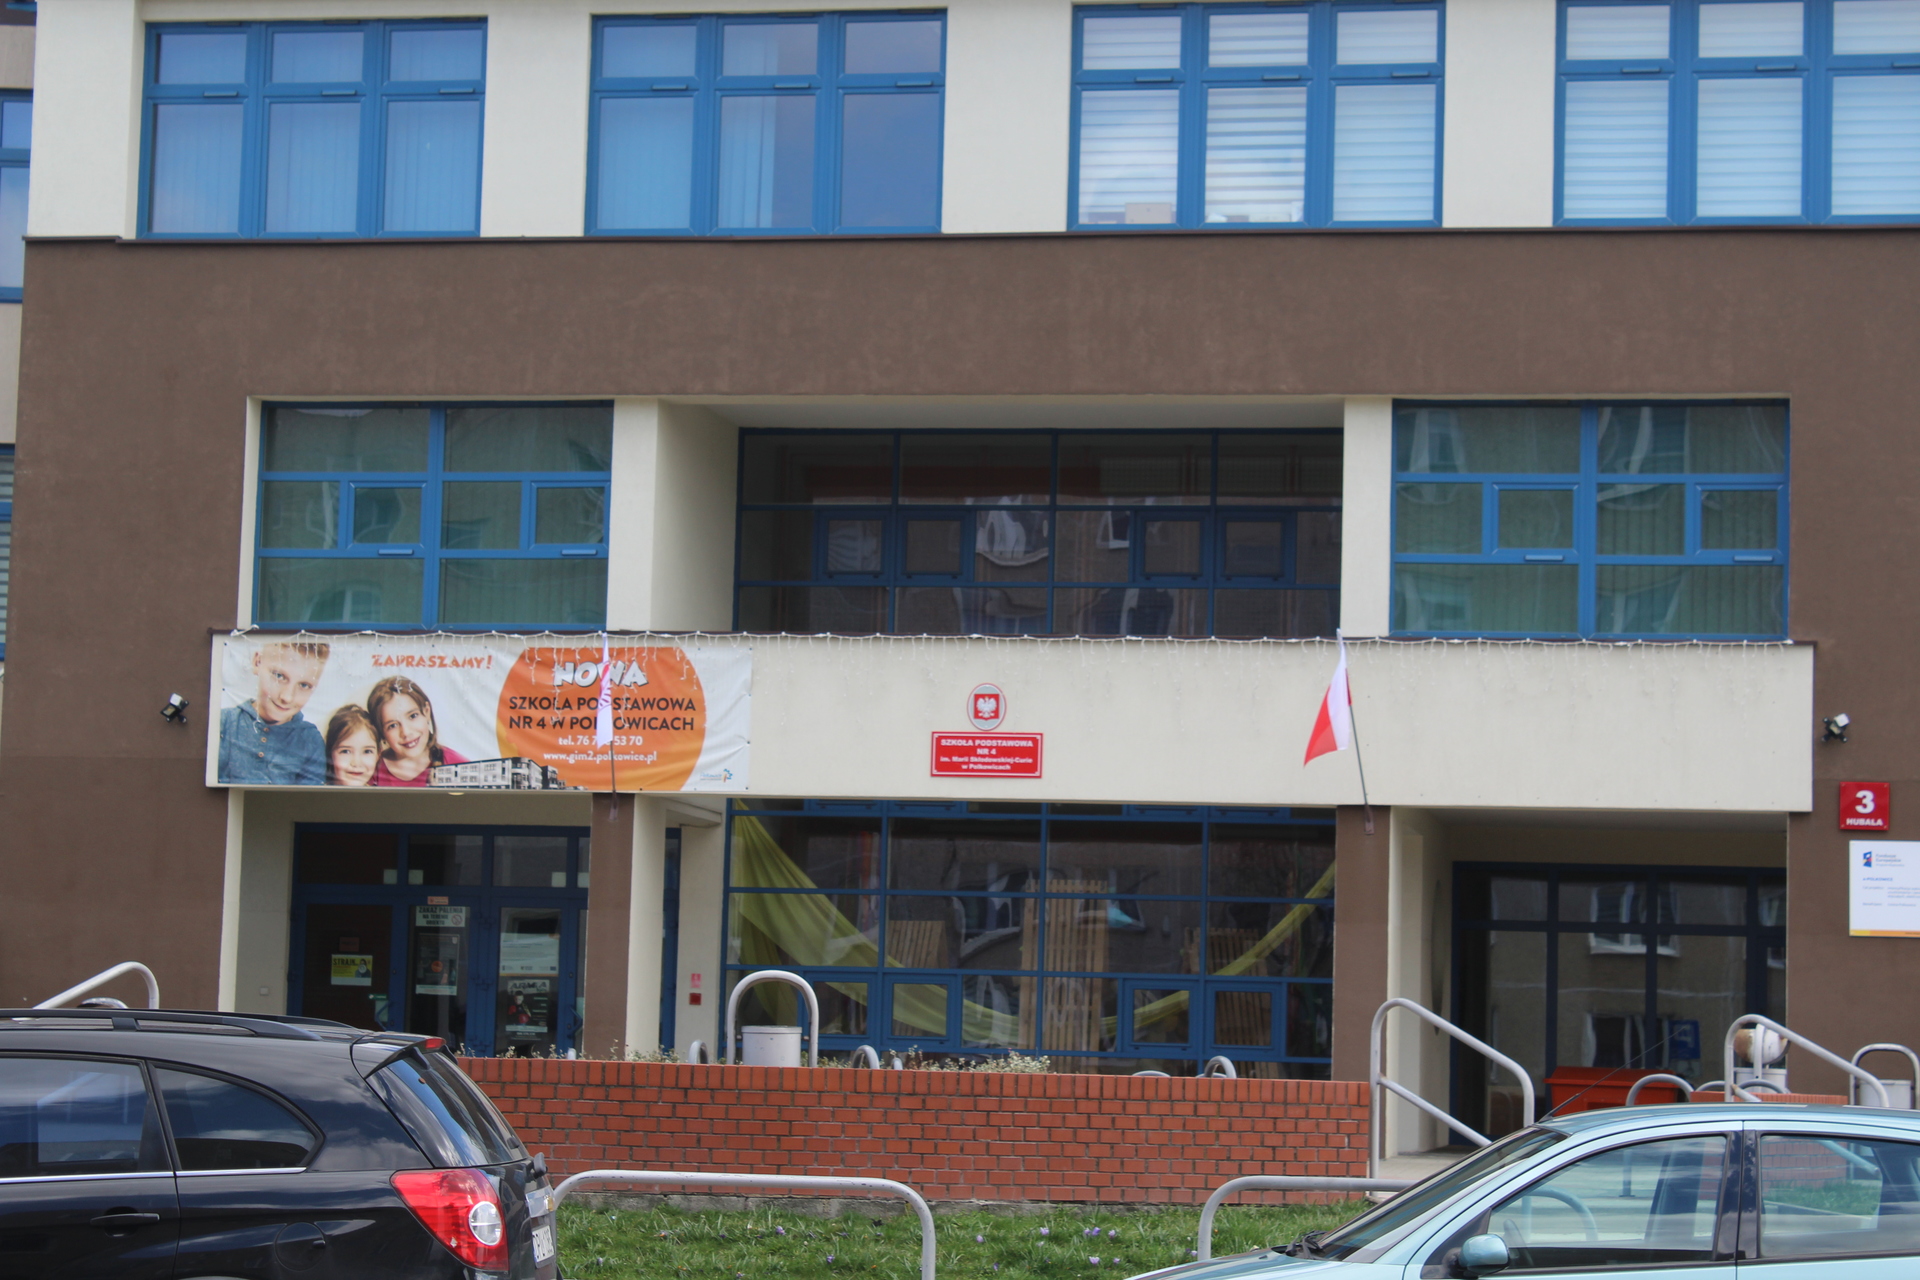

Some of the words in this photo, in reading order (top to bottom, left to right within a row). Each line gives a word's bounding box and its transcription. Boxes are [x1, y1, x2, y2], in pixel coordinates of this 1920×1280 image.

[371, 654, 492, 670] ZAPRASZAMY!
[553, 660, 649, 688] NOWA
[509, 696, 573, 711] SZKOŁA
[577, 696, 696, 712] POSTAWOWA
[509, 715, 533, 730] NR
[536, 716, 546, 730] 4
[551, 716, 565, 730] W
[558, 735, 574, 746] tel.
[577, 735, 590, 746] 76
[614, 735, 627, 746] 53
[629, 735, 643, 746] 70
[940, 739, 974, 747] SZKOŁA
[975, 739, 1034, 748] PODSTAWOWA
[543, 750, 657, 765] www.gim2.polkowice.pl
[1855, 790, 1875, 814] 3
[1846, 818, 1883, 826] HUBALA
